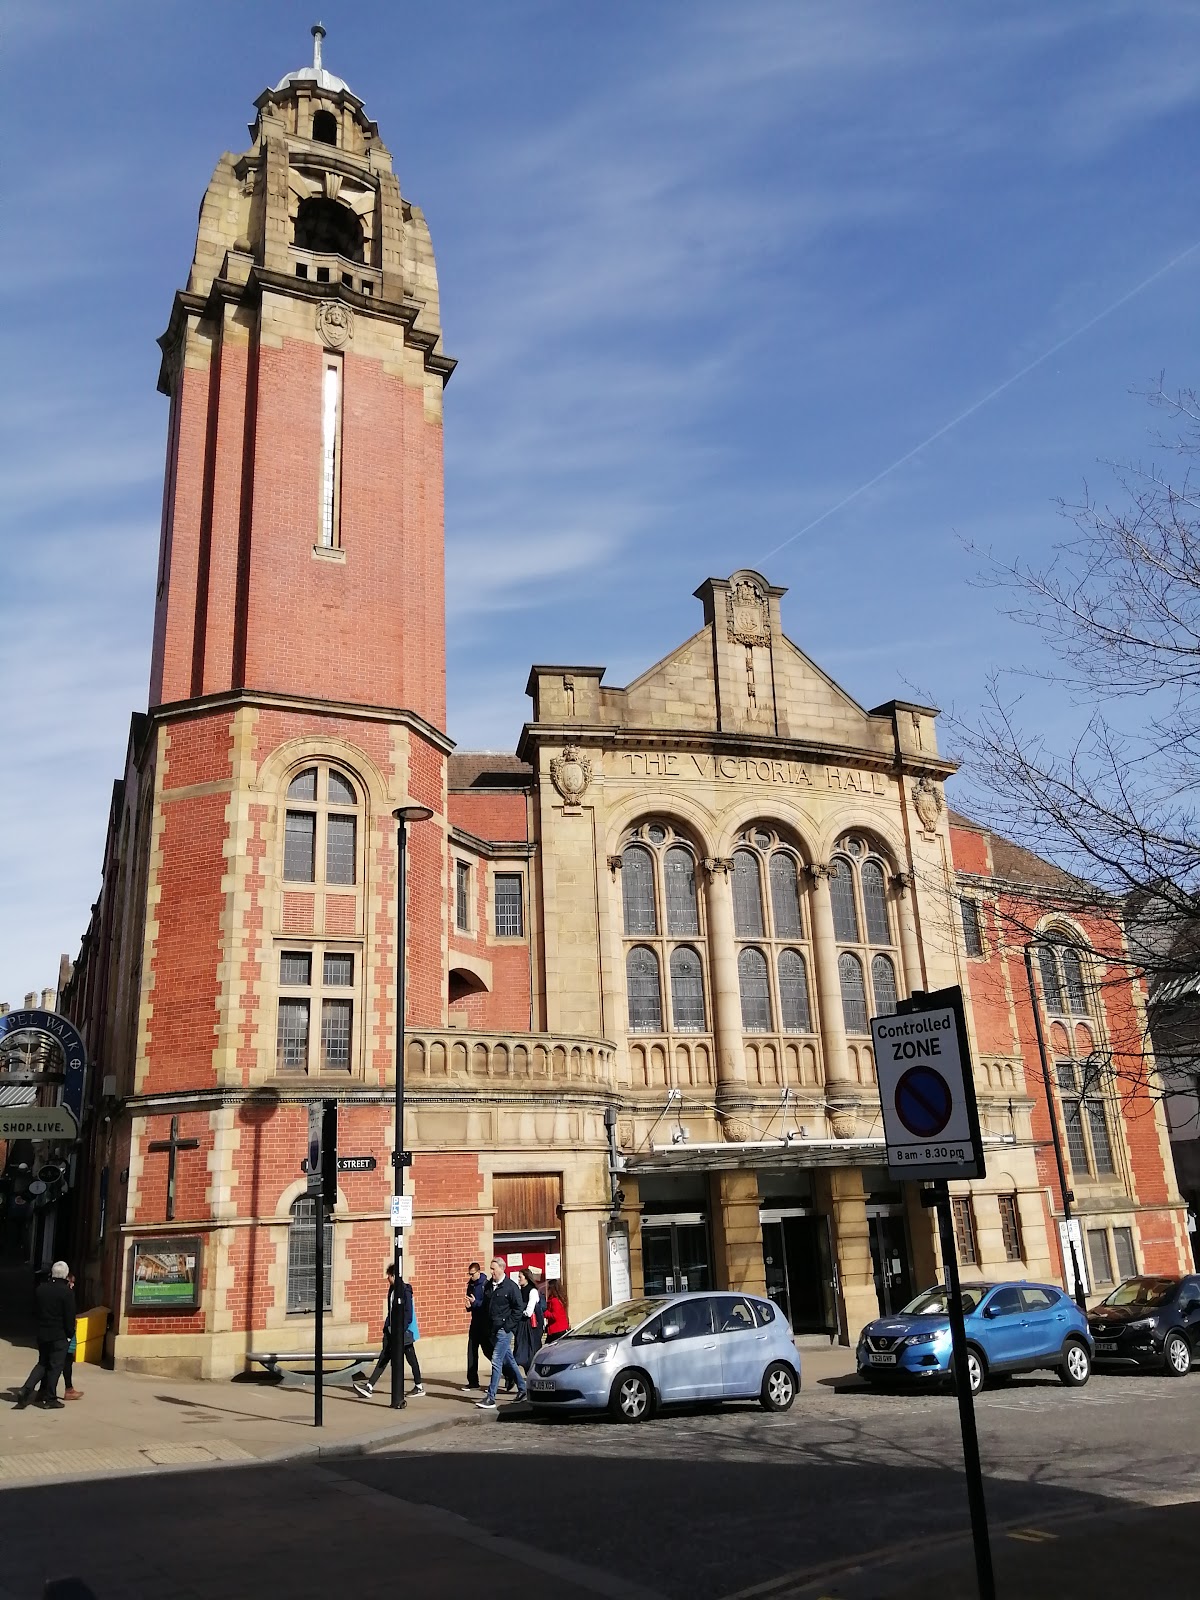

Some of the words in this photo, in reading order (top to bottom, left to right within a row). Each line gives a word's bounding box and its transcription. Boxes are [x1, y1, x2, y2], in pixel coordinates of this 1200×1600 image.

[622, 753, 680, 776] THE
[691, 755, 812, 786] VICTORIA
[826, 767, 886, 796] HALL
[46, 1016, 80, 1053] WALK
[877, 1014, 951, 1040] Controlled
[892, 1037, 942, 1061] ZONE
[343, 1160, 370, 1168] STREET
[897, 1150, 903, 1160] 8
[905, 1152, 918, 1160] am
[925, 1147, 948, 1159] 8.30
[949, 1148, 965, 1159] pm
